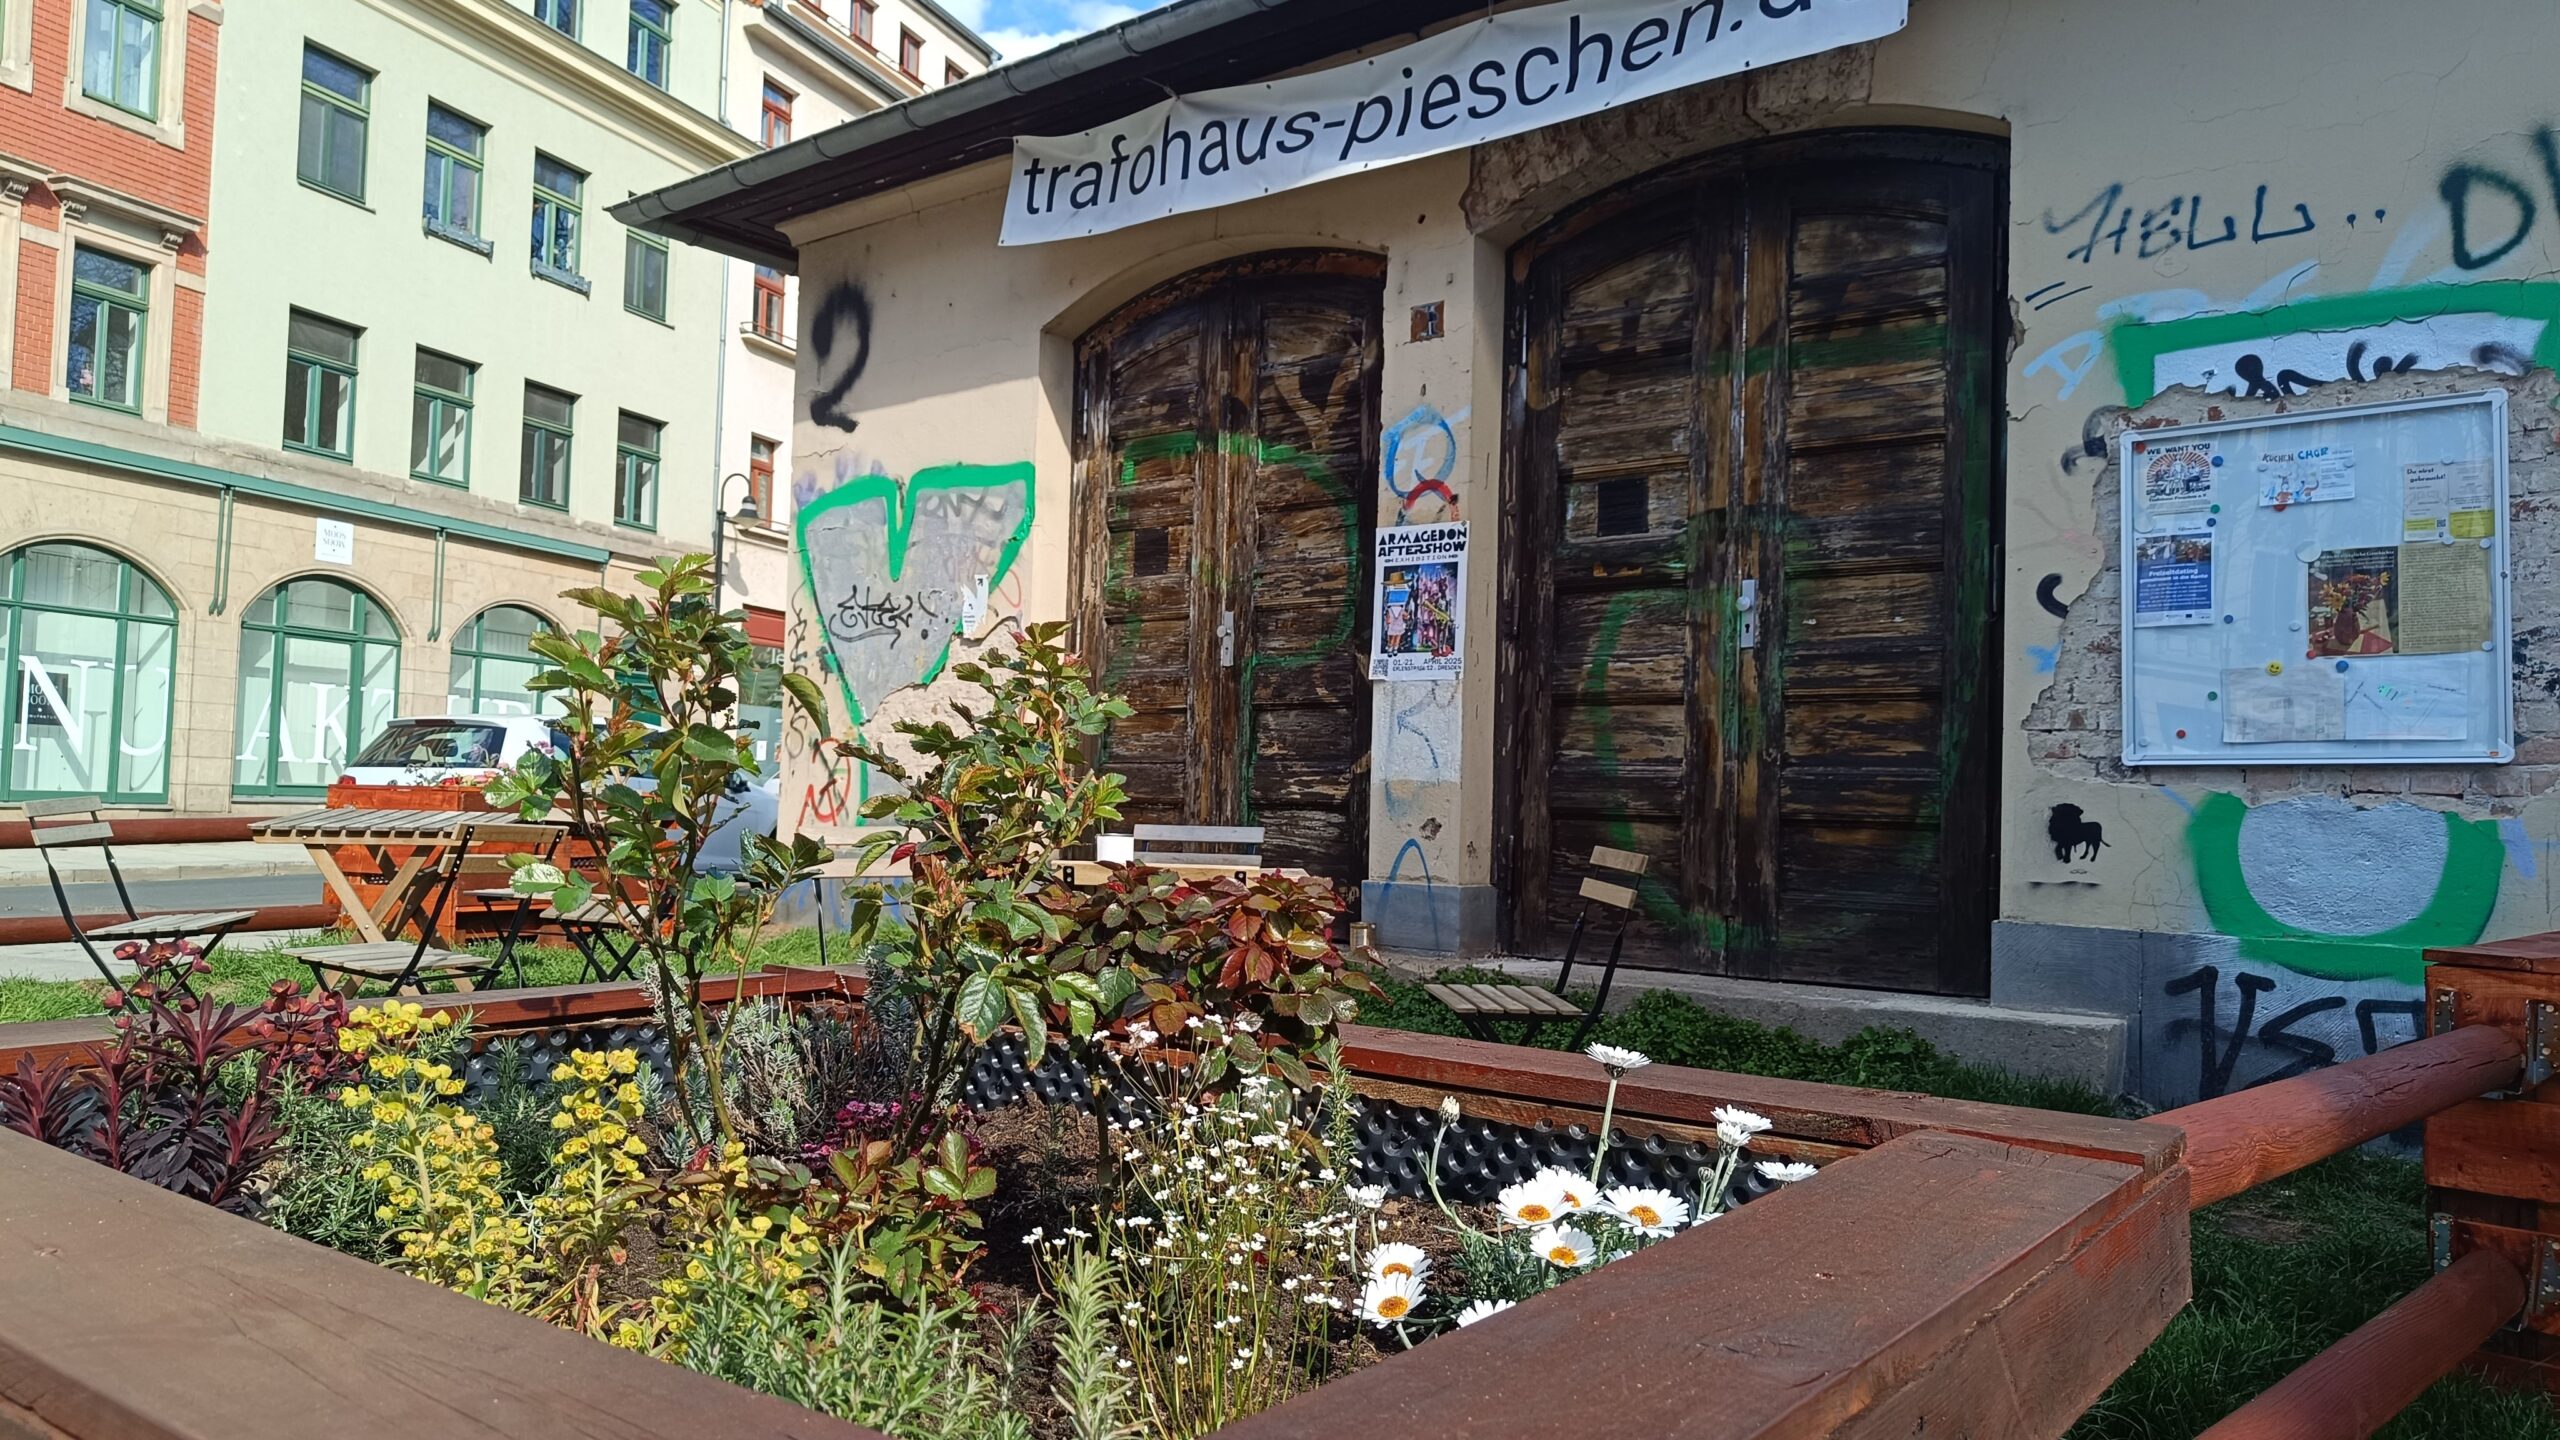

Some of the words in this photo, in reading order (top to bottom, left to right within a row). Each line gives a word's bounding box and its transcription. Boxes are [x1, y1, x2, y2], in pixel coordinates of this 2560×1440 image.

[1023, 0, 1856, 215] trafohaus-pieschen.
[810, 281, 873, 433] 2
[2146, 447, 2161, 456] WE
[2165, 445, 2190, 453] WANT
[2298, 447, 2329, 460] CHOR
[1378, 527, 1468, 546] ARMAGEDON
[1377, 541, 1467, 557] AFTERSHOW
[1394, 554, 1448, 562] EXHIBITION
[2149, 568, 2199, 577] Freizeitdating
[1423, 657, 1443, 665] APRIL
[1443, 657, 1463, 665] 2025
